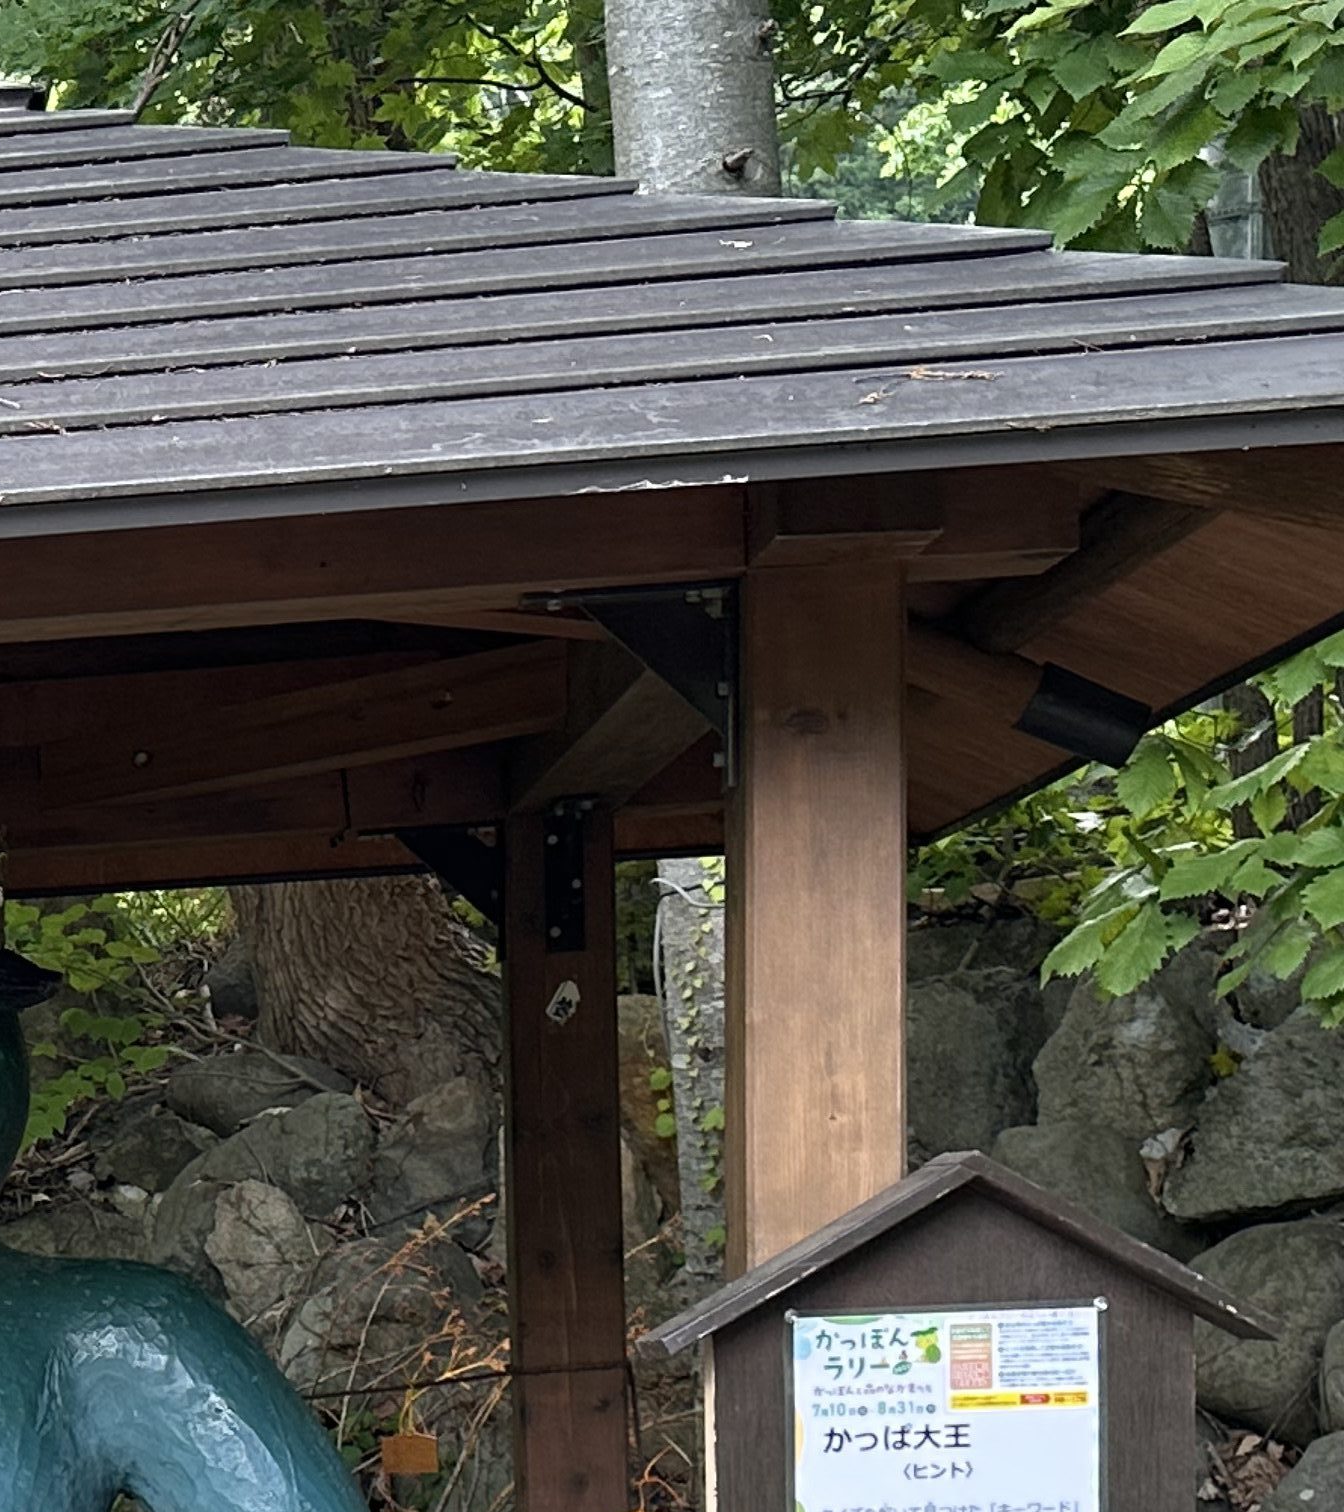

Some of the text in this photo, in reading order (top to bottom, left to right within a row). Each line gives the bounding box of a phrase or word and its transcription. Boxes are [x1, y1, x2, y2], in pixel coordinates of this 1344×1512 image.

[823, 1356, 890, 1380] ラリー
[823, 1422, 972, 1454] かっぱ大王
